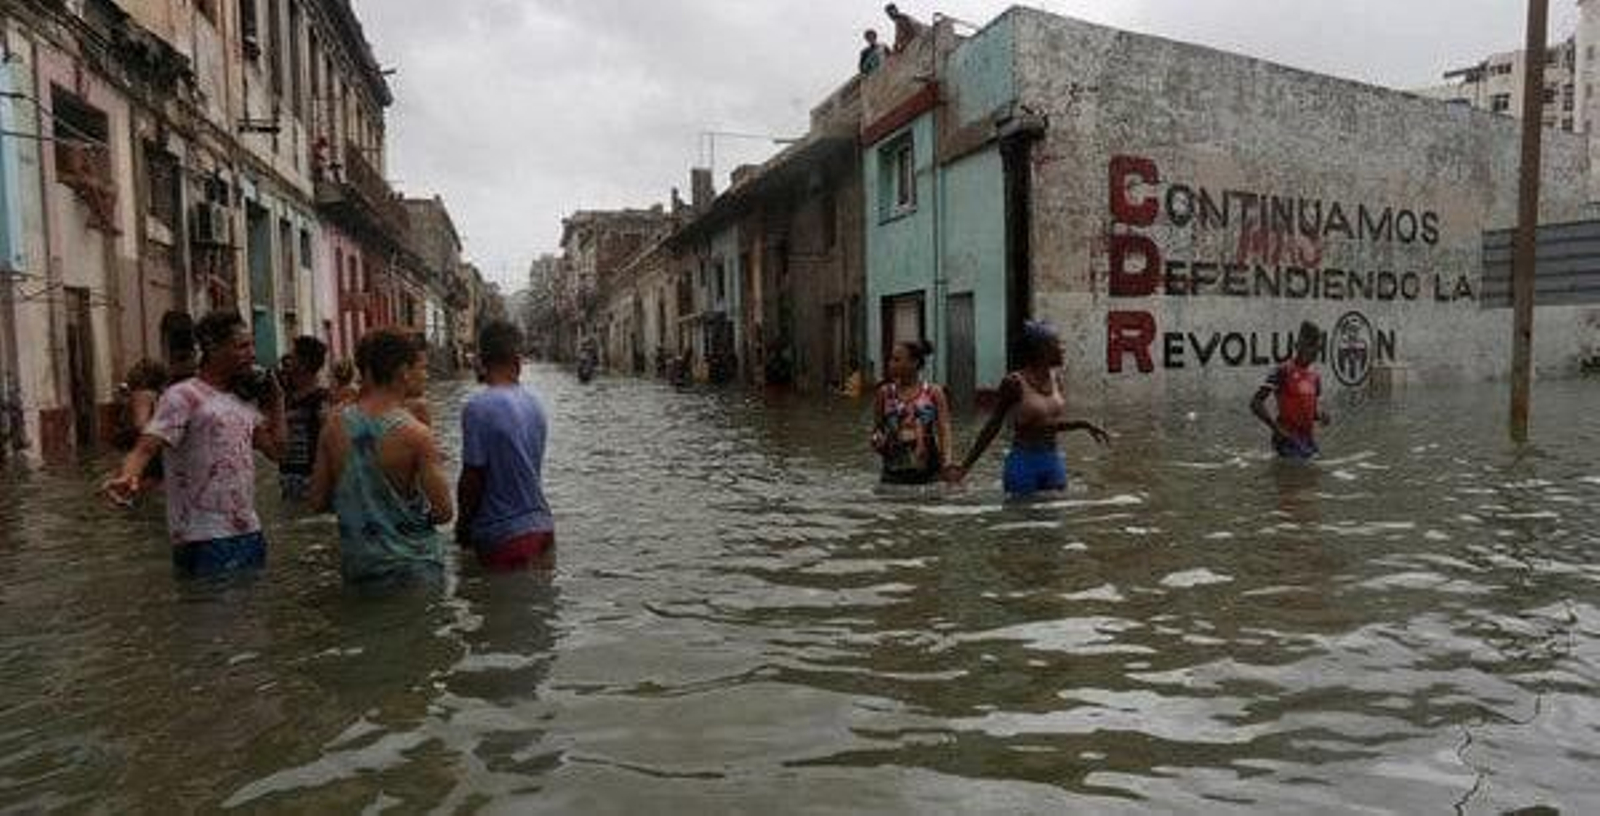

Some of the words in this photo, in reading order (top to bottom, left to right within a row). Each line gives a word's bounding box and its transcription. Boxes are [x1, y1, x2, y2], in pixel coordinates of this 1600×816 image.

[1108, 154, 1440, 246] CONTINUAMOS
[1108, 234, 1421, 302] DEFENDIENDO
[1433, 273, 1476, 303] LA
[1107, 310, 1396, 386] REVOLUION
